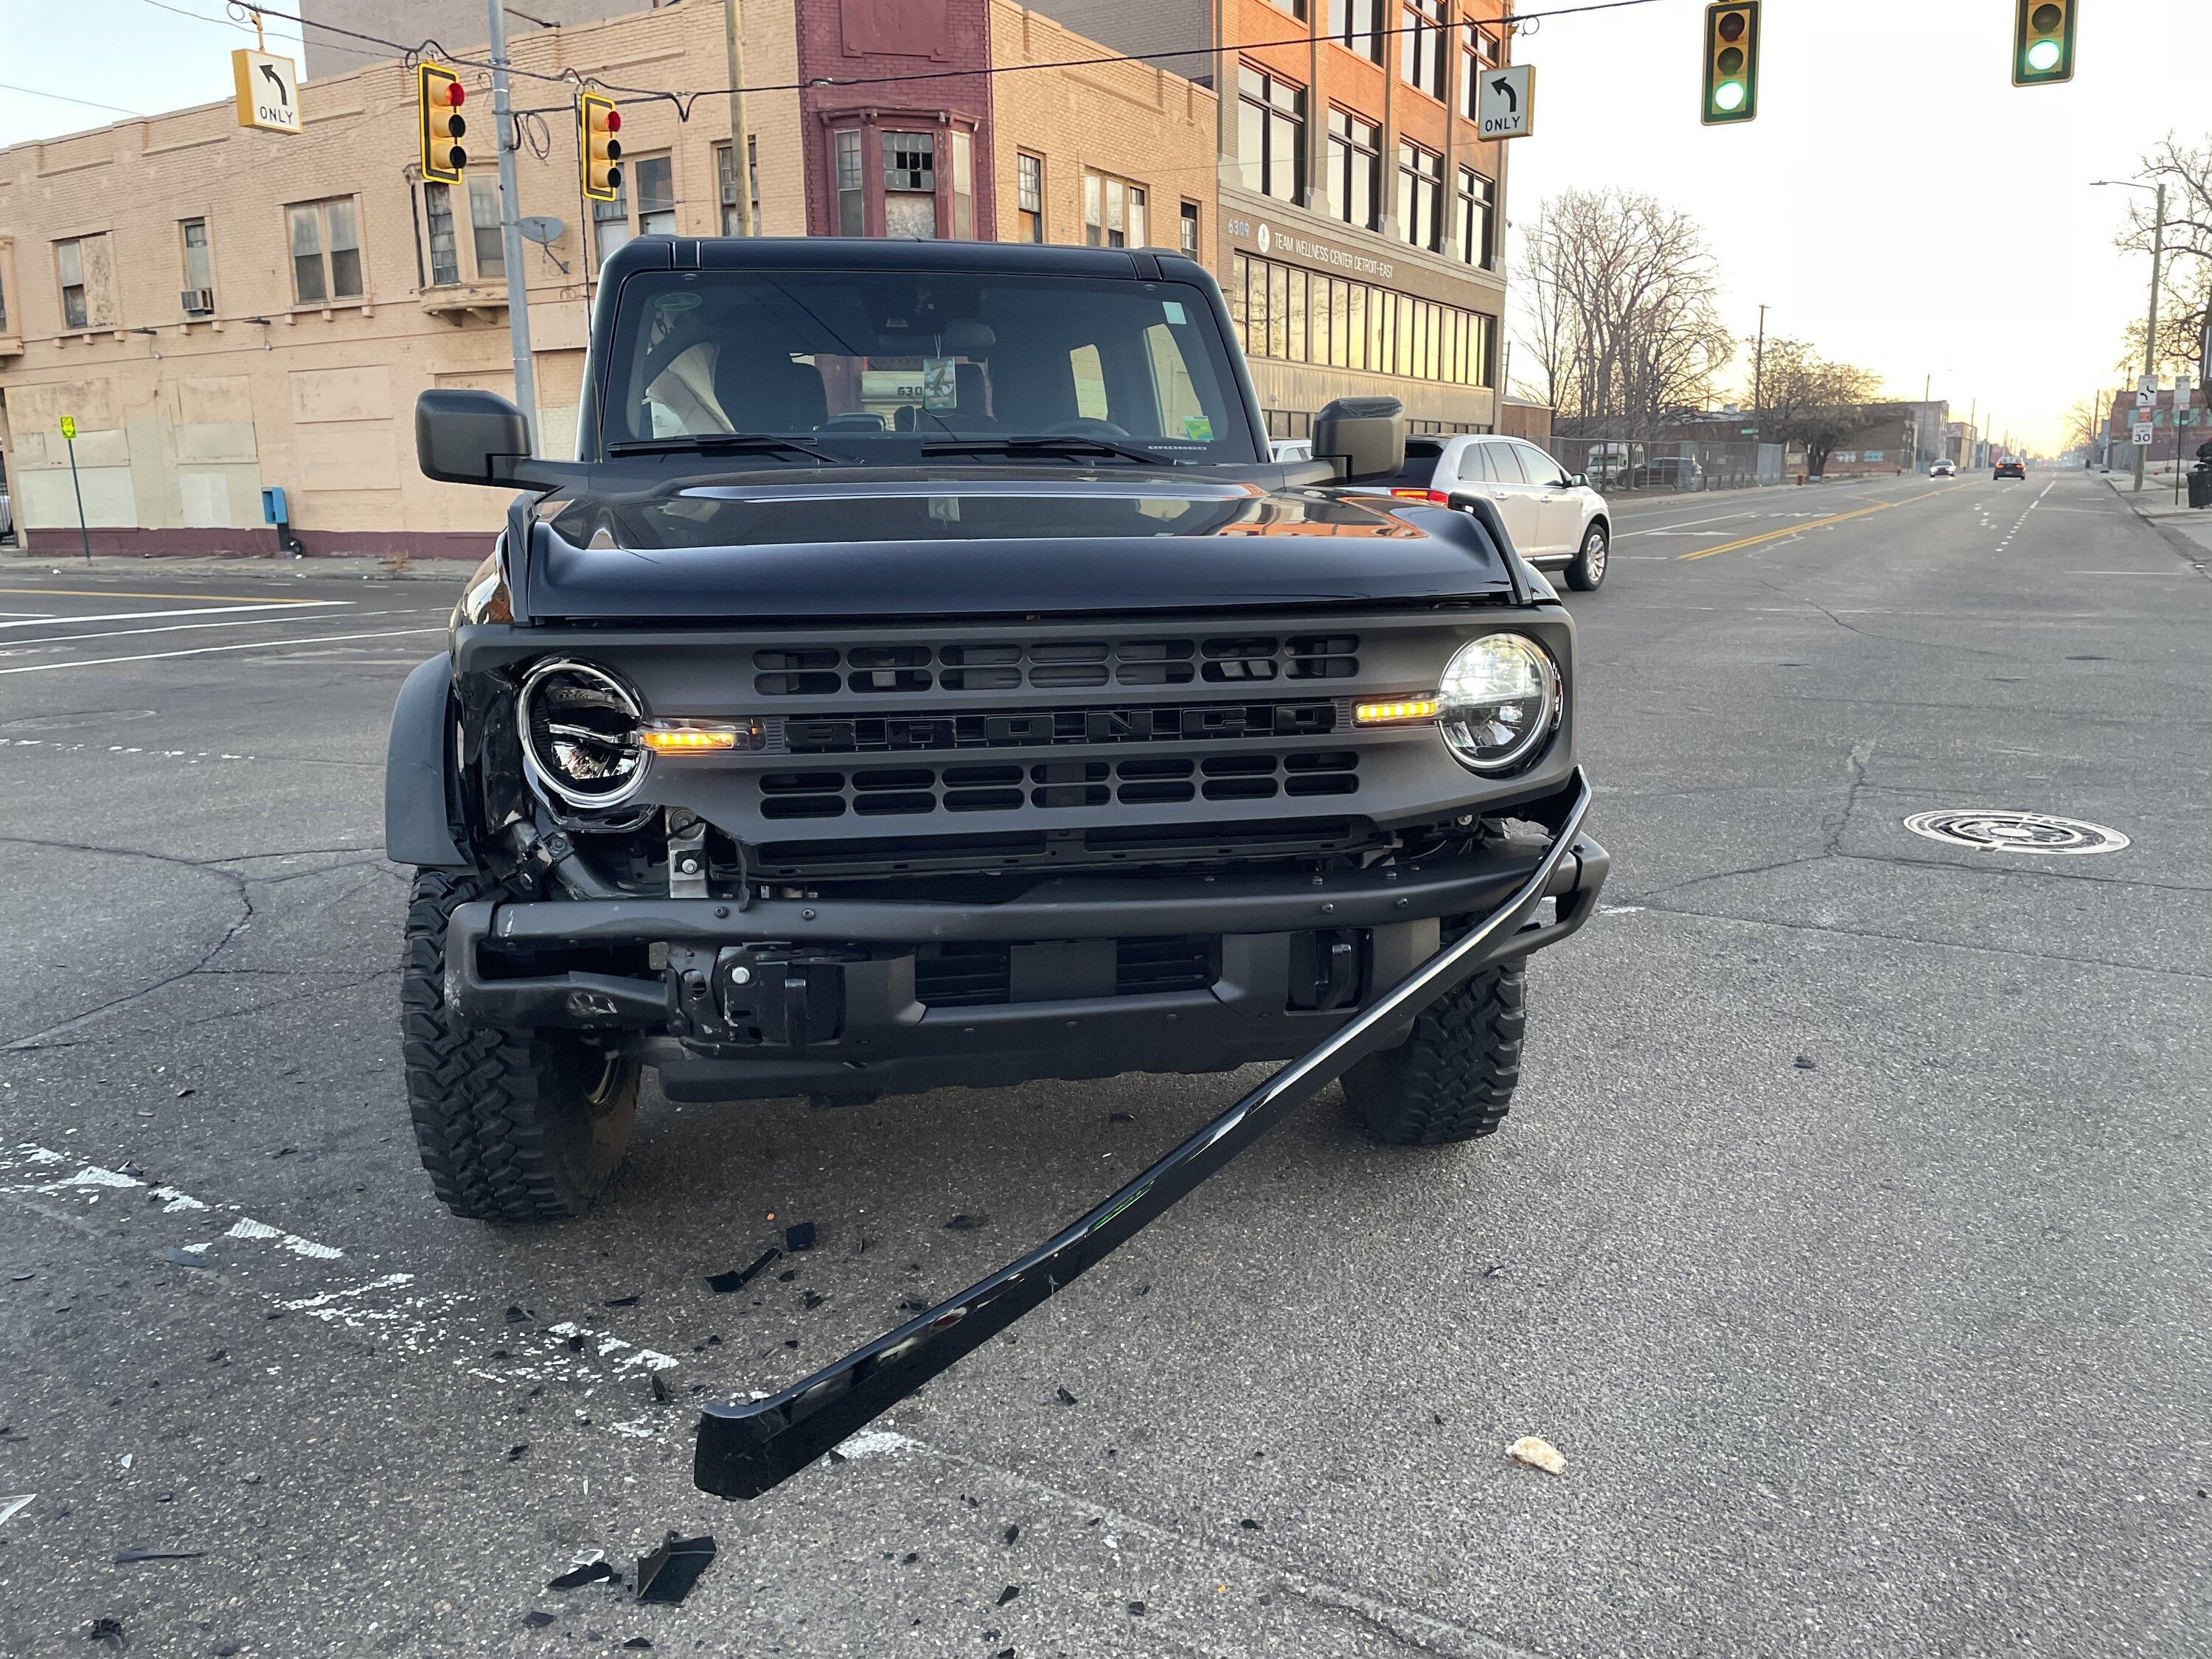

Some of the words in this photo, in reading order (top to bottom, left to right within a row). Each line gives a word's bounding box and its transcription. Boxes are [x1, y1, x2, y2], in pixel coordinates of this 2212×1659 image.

[260, 106, 293, 125] ONLY
[1485, 116, 1520, 132] ONLY
[1228, 218, 1250, 237] 6309
[1274, 232, 1293, 251] TEAM
[1295, 238, 1329, 262] WELLNESS
[1330, 248, 1353, 268] CENTER
[2134, 434, 2150, 442] 30
[784, 703, 1338, 748] BRONCO
